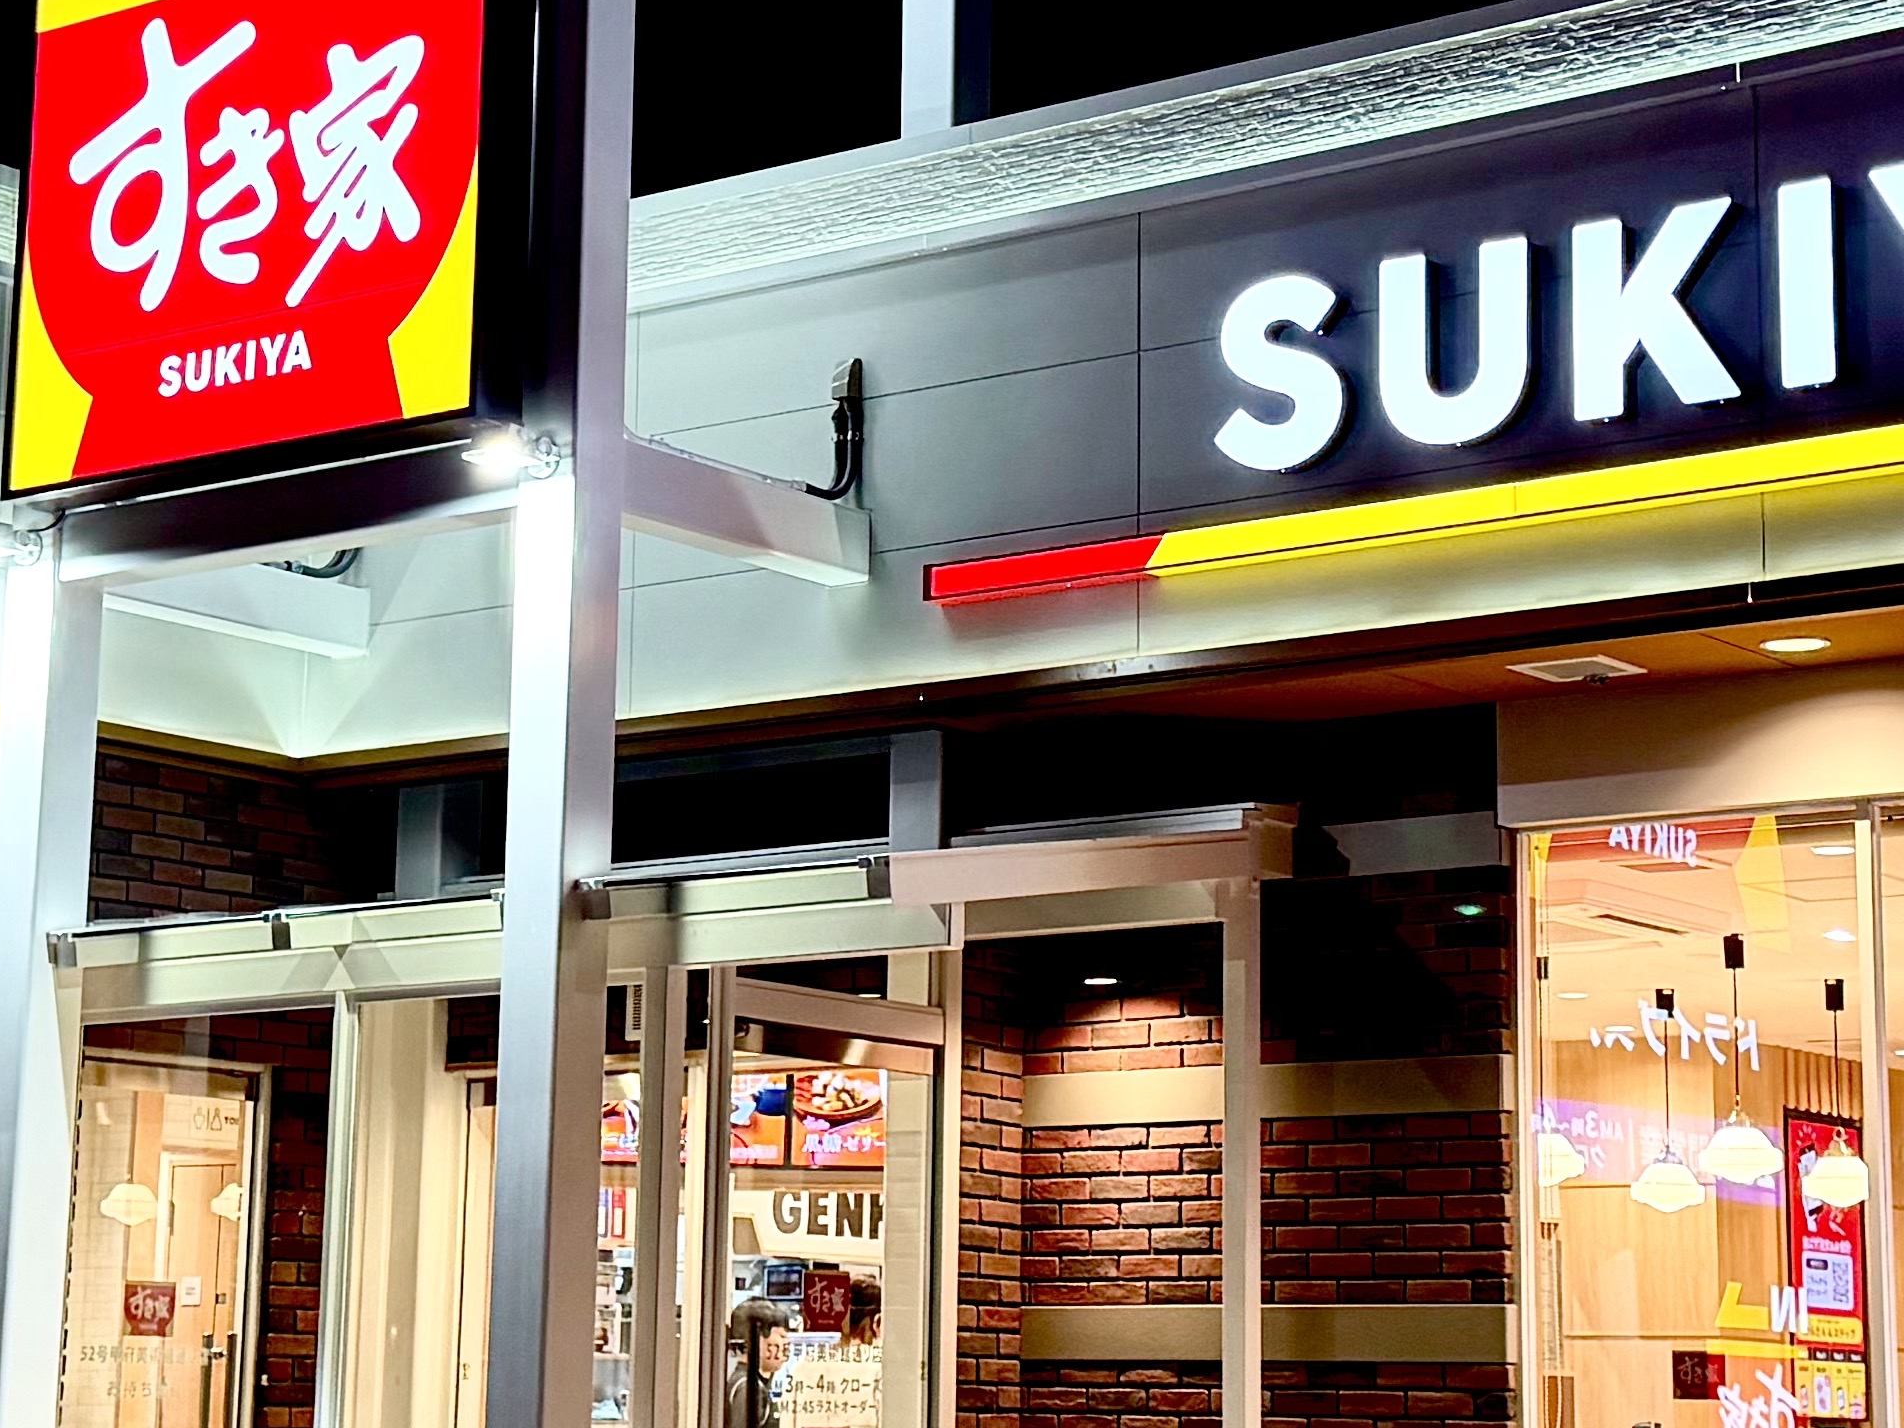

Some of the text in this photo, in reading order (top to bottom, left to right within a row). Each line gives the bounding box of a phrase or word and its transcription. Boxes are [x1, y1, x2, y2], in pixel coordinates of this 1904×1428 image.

[68, 17, 425, 313] すき家
[157, 328, 313, 399] SUKIYA
